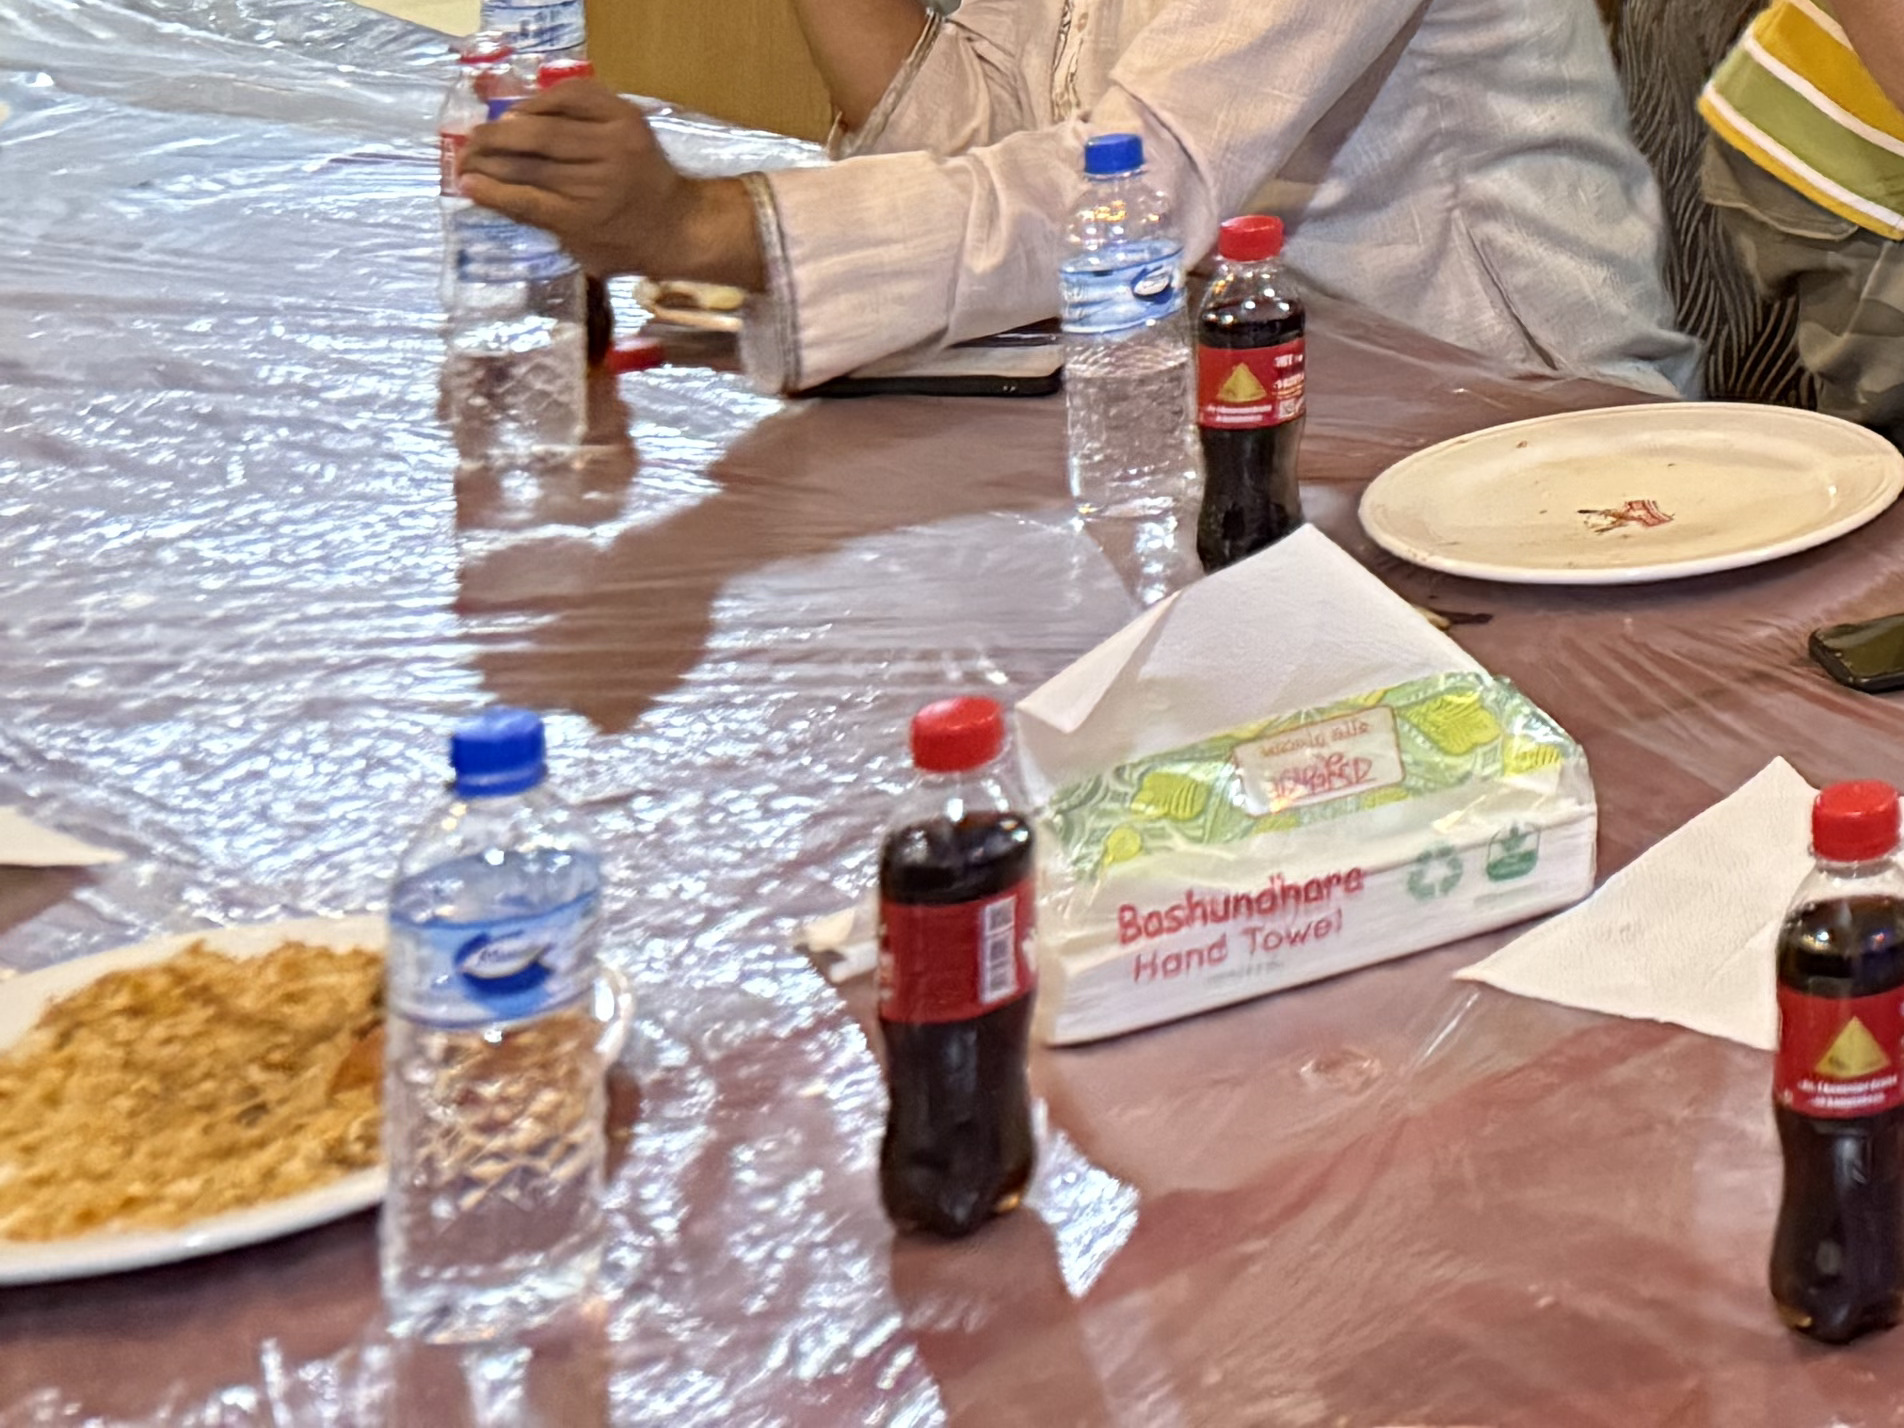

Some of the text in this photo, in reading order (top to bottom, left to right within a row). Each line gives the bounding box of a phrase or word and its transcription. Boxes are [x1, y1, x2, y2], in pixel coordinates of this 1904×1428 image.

[1116, 865, 1365, 946] Bashundhara
[1131, 927, 1229, 983] Hand
[1240, 906, 1345, 954] Towel
